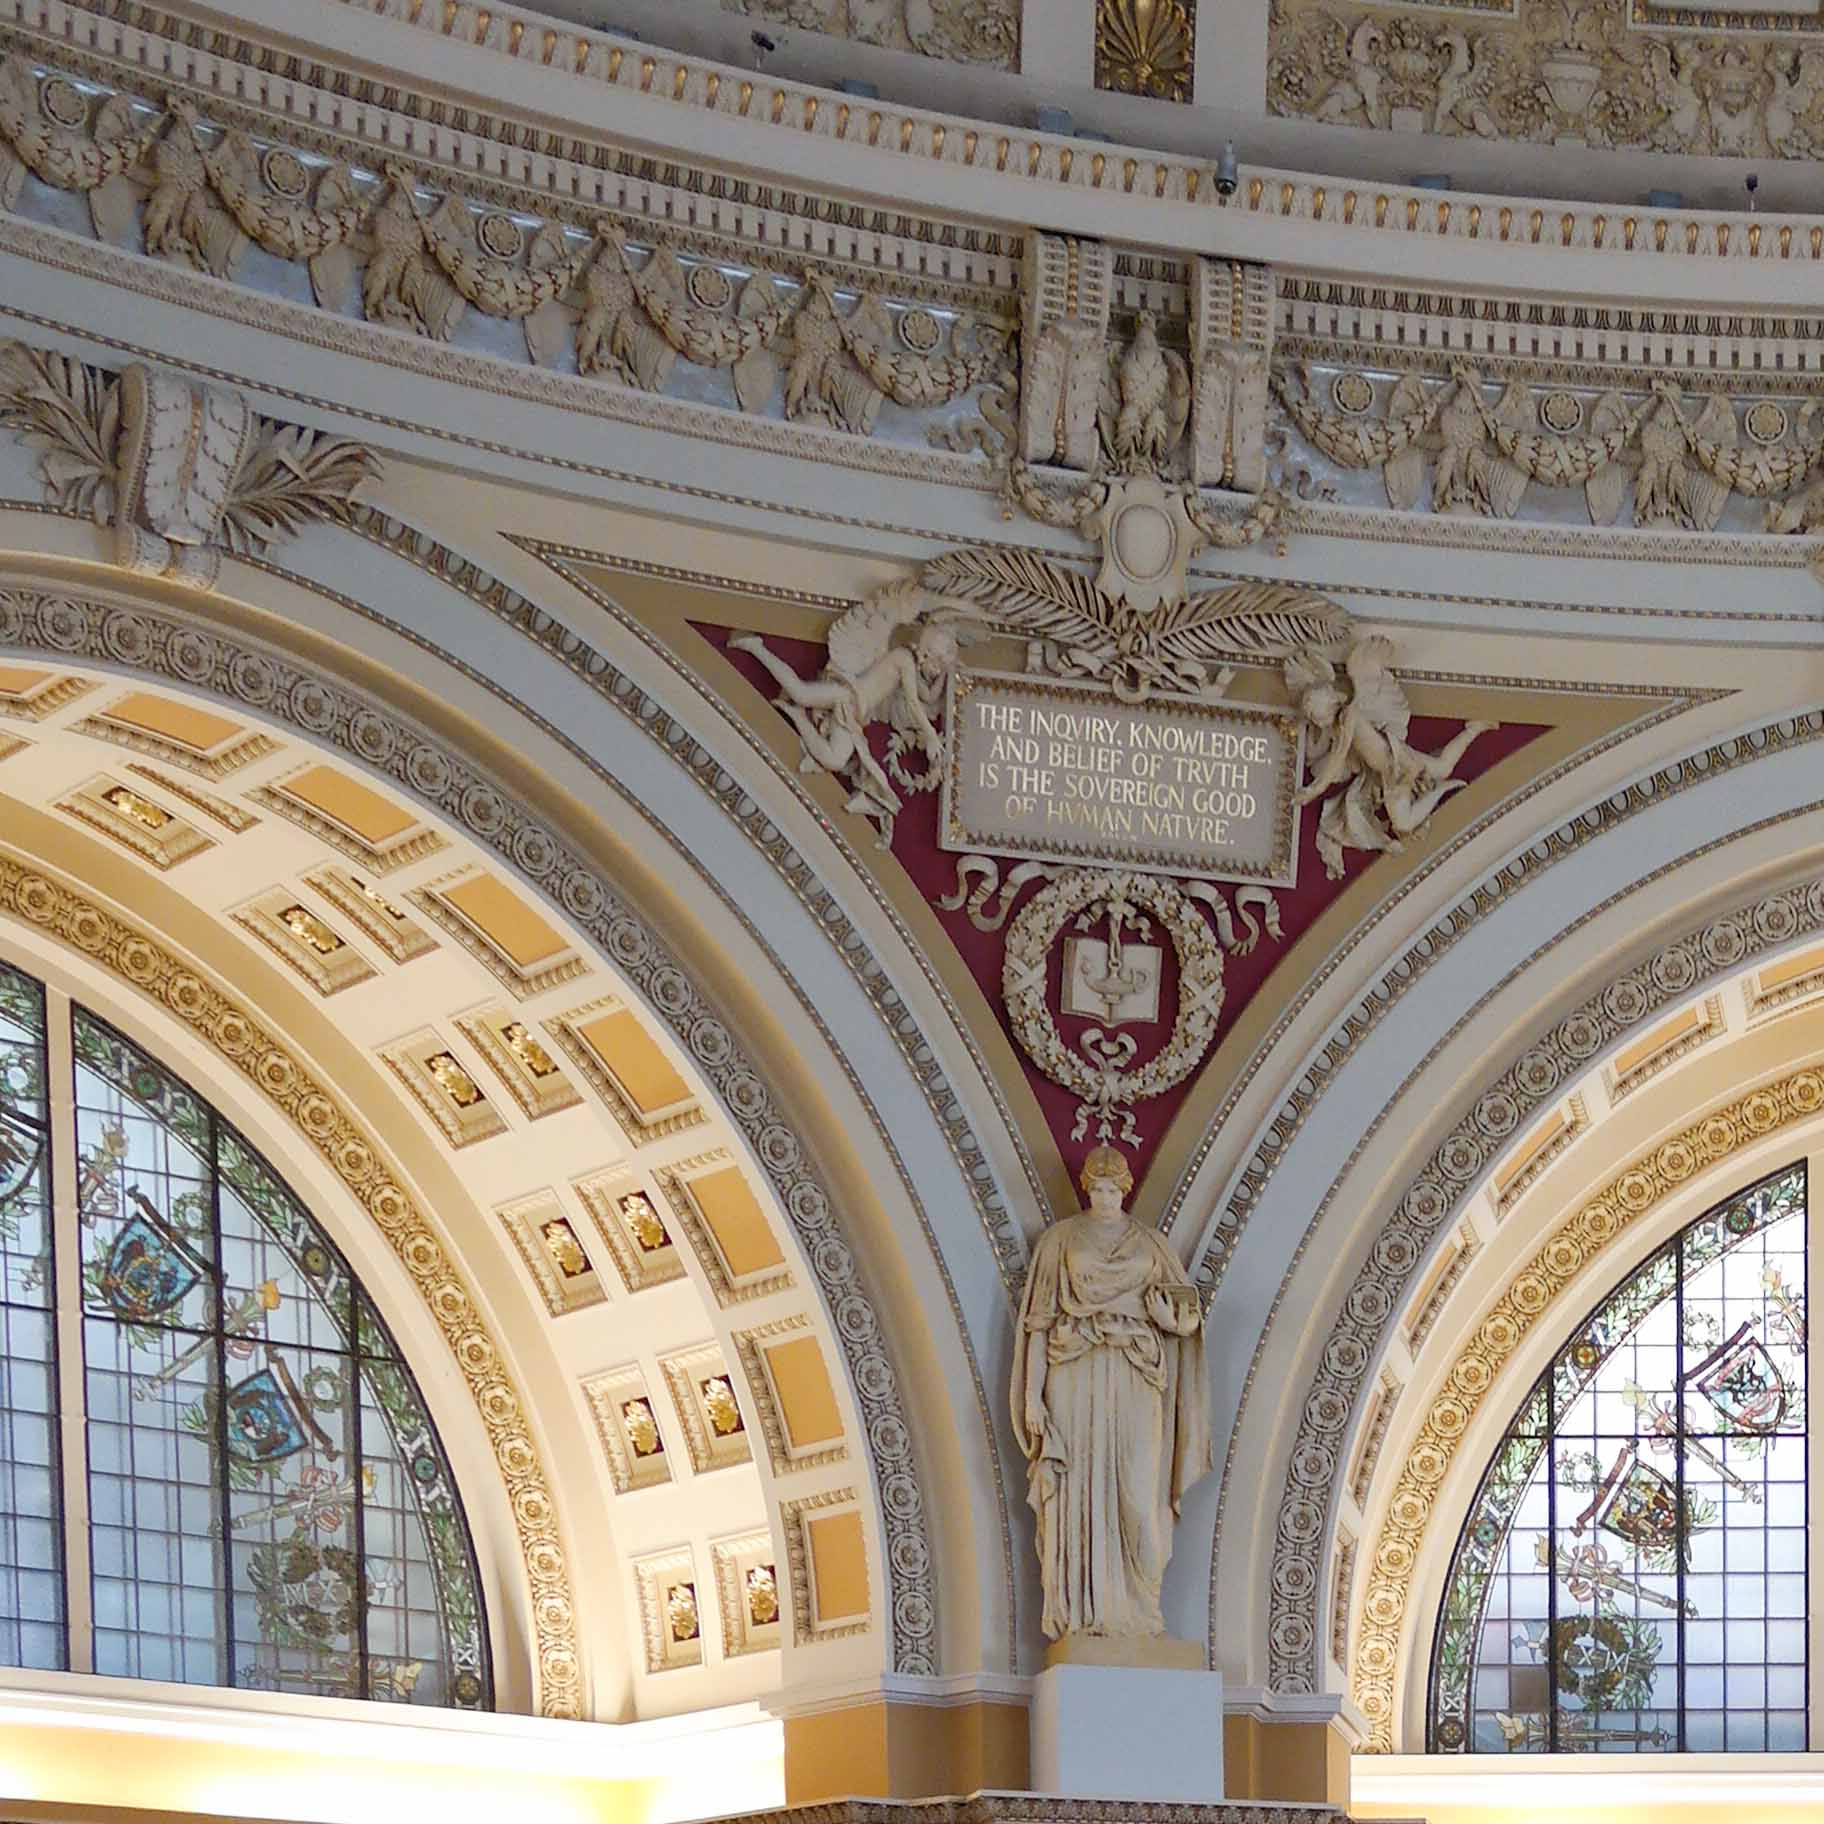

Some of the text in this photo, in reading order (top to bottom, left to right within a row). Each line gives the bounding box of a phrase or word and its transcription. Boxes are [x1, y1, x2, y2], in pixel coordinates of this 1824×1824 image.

[976, 703, 1023, 733] THE
[990, 735, 1248, 789] AND BELIEF OF TRVTH
[980, 763, 1257, 818] IS THE SOVEREIGN GOOD
[1006, 795, 1038, 819] OF
[1048, 800, 1132, 833] HVMAN
[1142, 810, 1235, 845] NATVRE.
